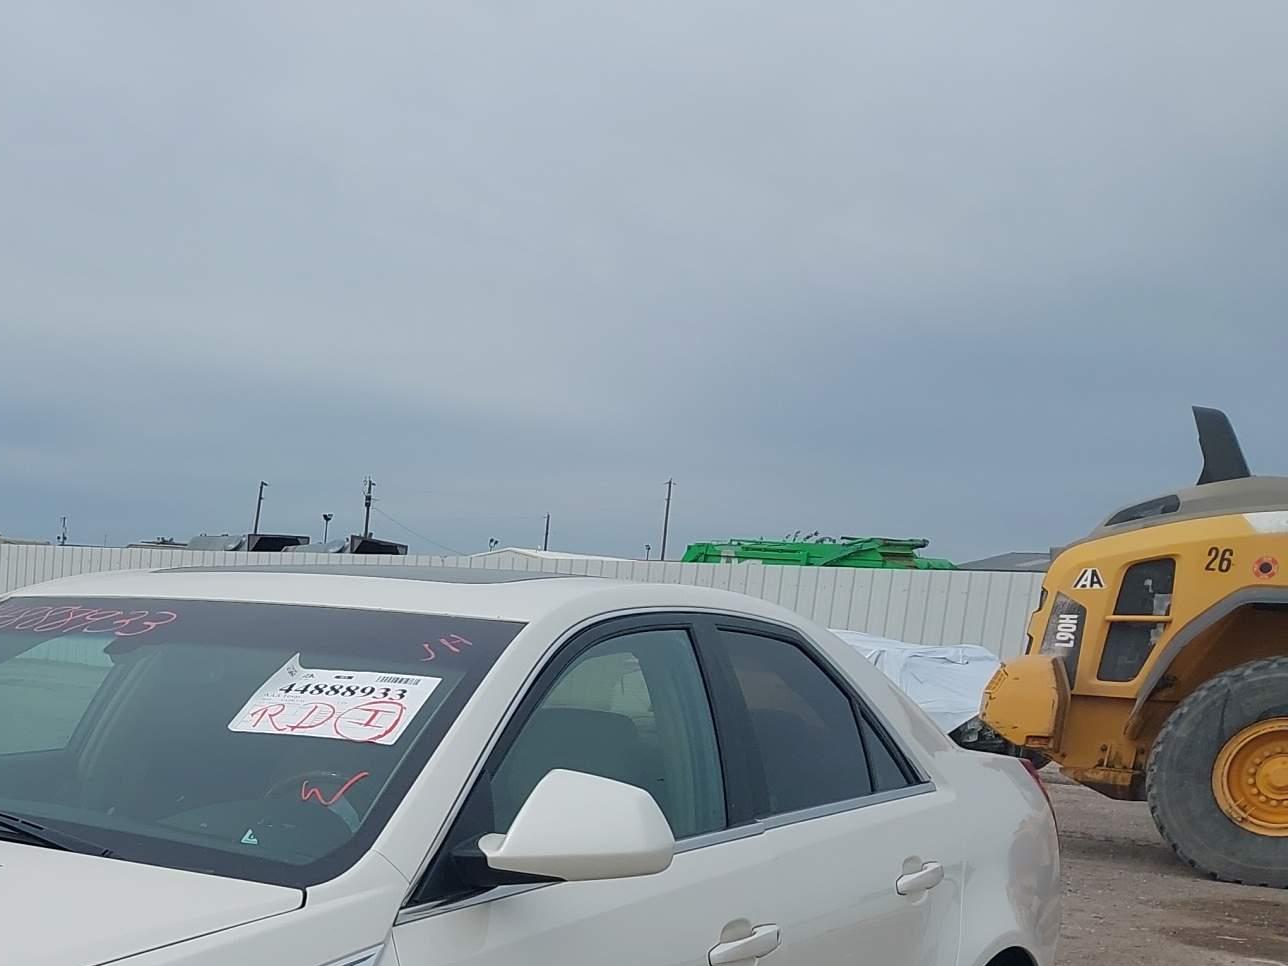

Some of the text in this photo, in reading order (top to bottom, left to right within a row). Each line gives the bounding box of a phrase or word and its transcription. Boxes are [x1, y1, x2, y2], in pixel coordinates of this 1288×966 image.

[1204, 546, 1234, 573] 26
[1054, 613, 1079, 648] L90H
[278, 682, 408, 702] 44888933
